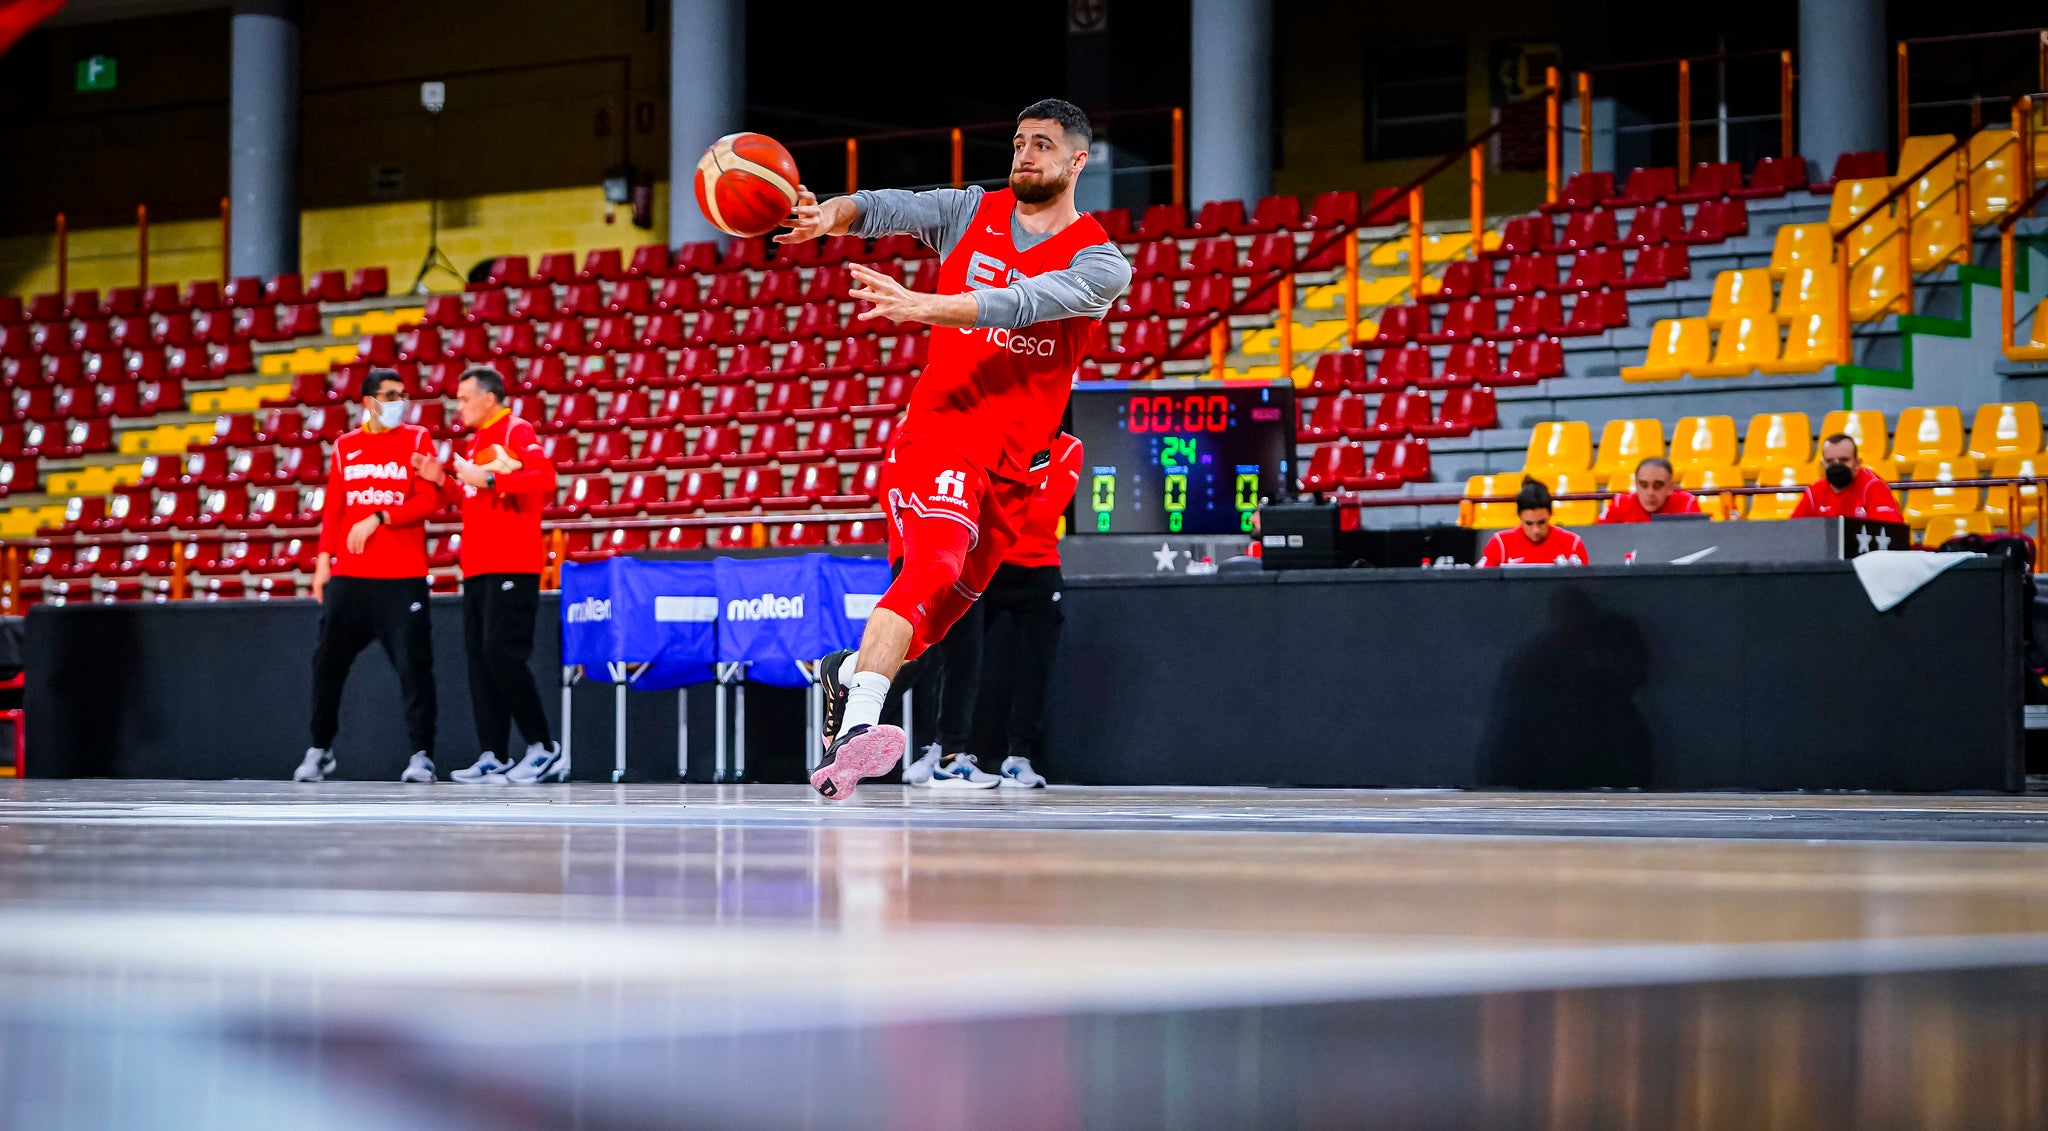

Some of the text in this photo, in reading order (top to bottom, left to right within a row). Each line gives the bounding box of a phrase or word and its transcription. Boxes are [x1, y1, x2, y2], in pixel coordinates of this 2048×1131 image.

[1128, 396, 1228, 433] 00:00
[1161, 436, 1197, 466] 24
[344, 461, 408, 481] ESPAÑA
[935, 470, 967, 498] fi
[928, 493, 969, 510] network
[1092, 474, 1259, 512] 0 0 0
[726, 593, 805, 622] molten
